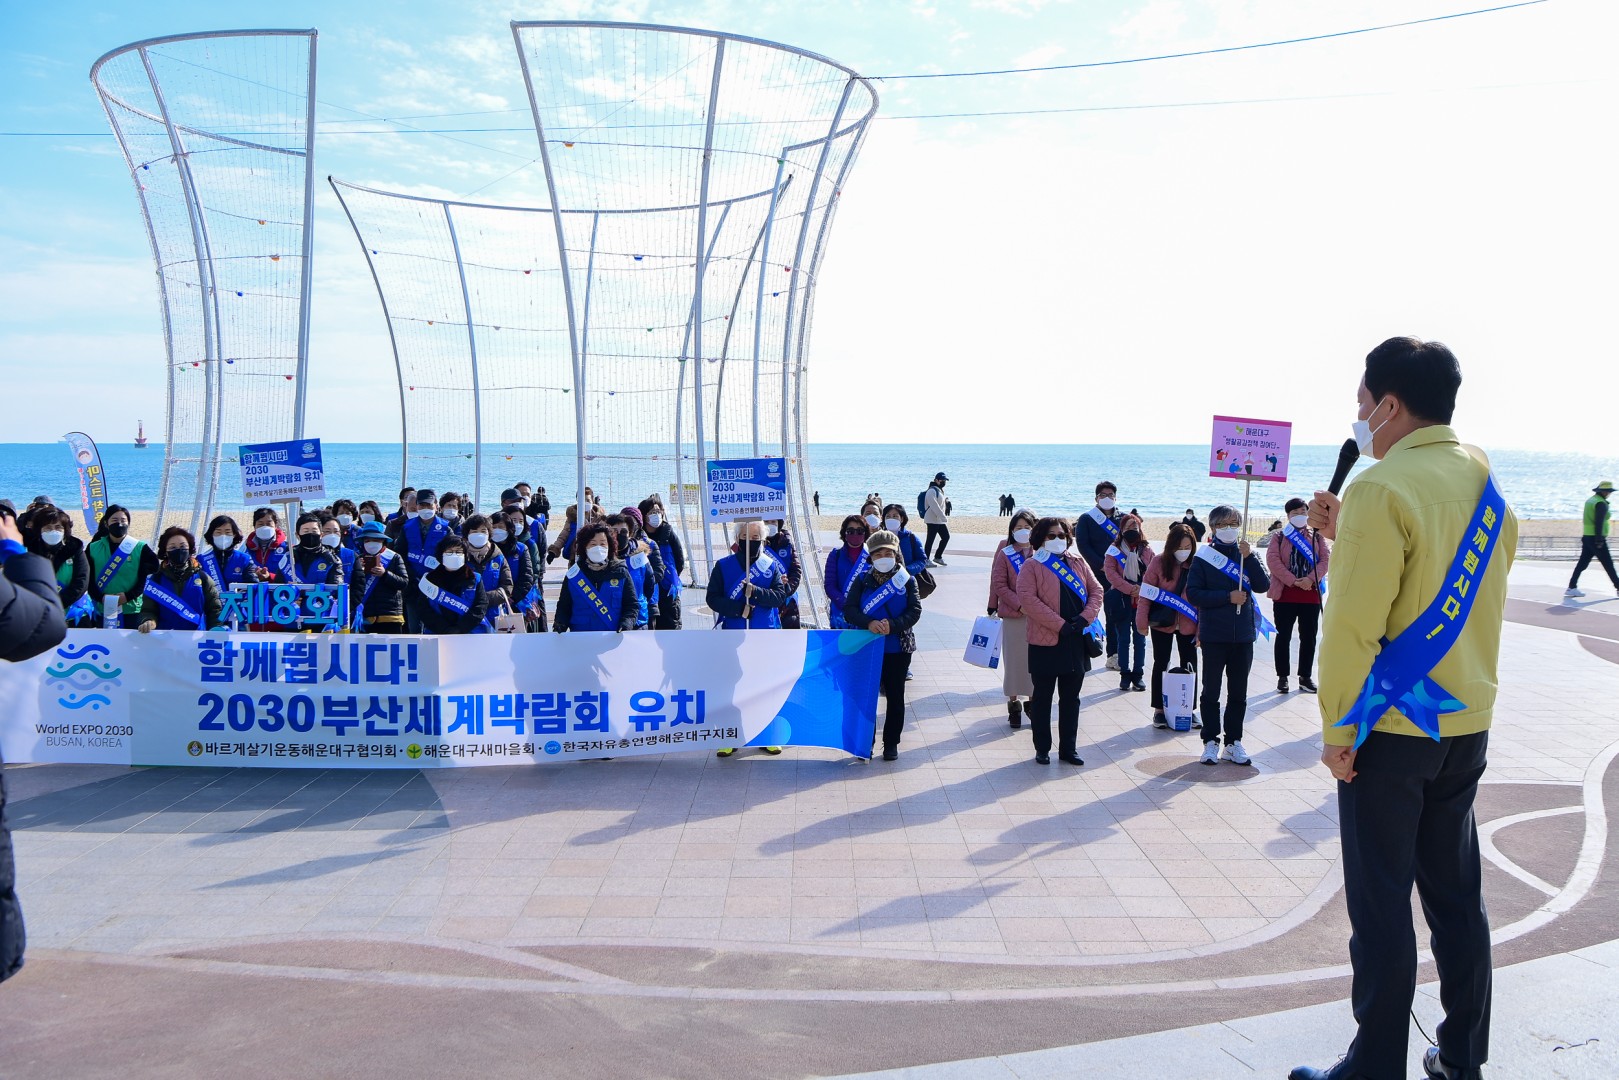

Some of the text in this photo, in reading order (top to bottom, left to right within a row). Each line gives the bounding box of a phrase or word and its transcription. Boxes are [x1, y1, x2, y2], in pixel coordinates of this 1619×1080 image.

[245, 465, 269, 475] 2030
[246, 471, 320, 487] 부산세계박람회 유치
[712, 482, 735, 492] 2030
[712, 492, 765, 504] 부산세계박람회
[767, 490, 783, 502] 유치
[217, 582, 344, 626] 제8회
[197, 638, 418, 685] 함께뜁시다!
[628, 688, 706, 731] 유치
[35, 723, 134, 736] World EXPO 2030
[46, 736, 123, 748] BUSAN, KOREA
[563, 727, 738, 753] 한국자유총연맹해운대구지회
